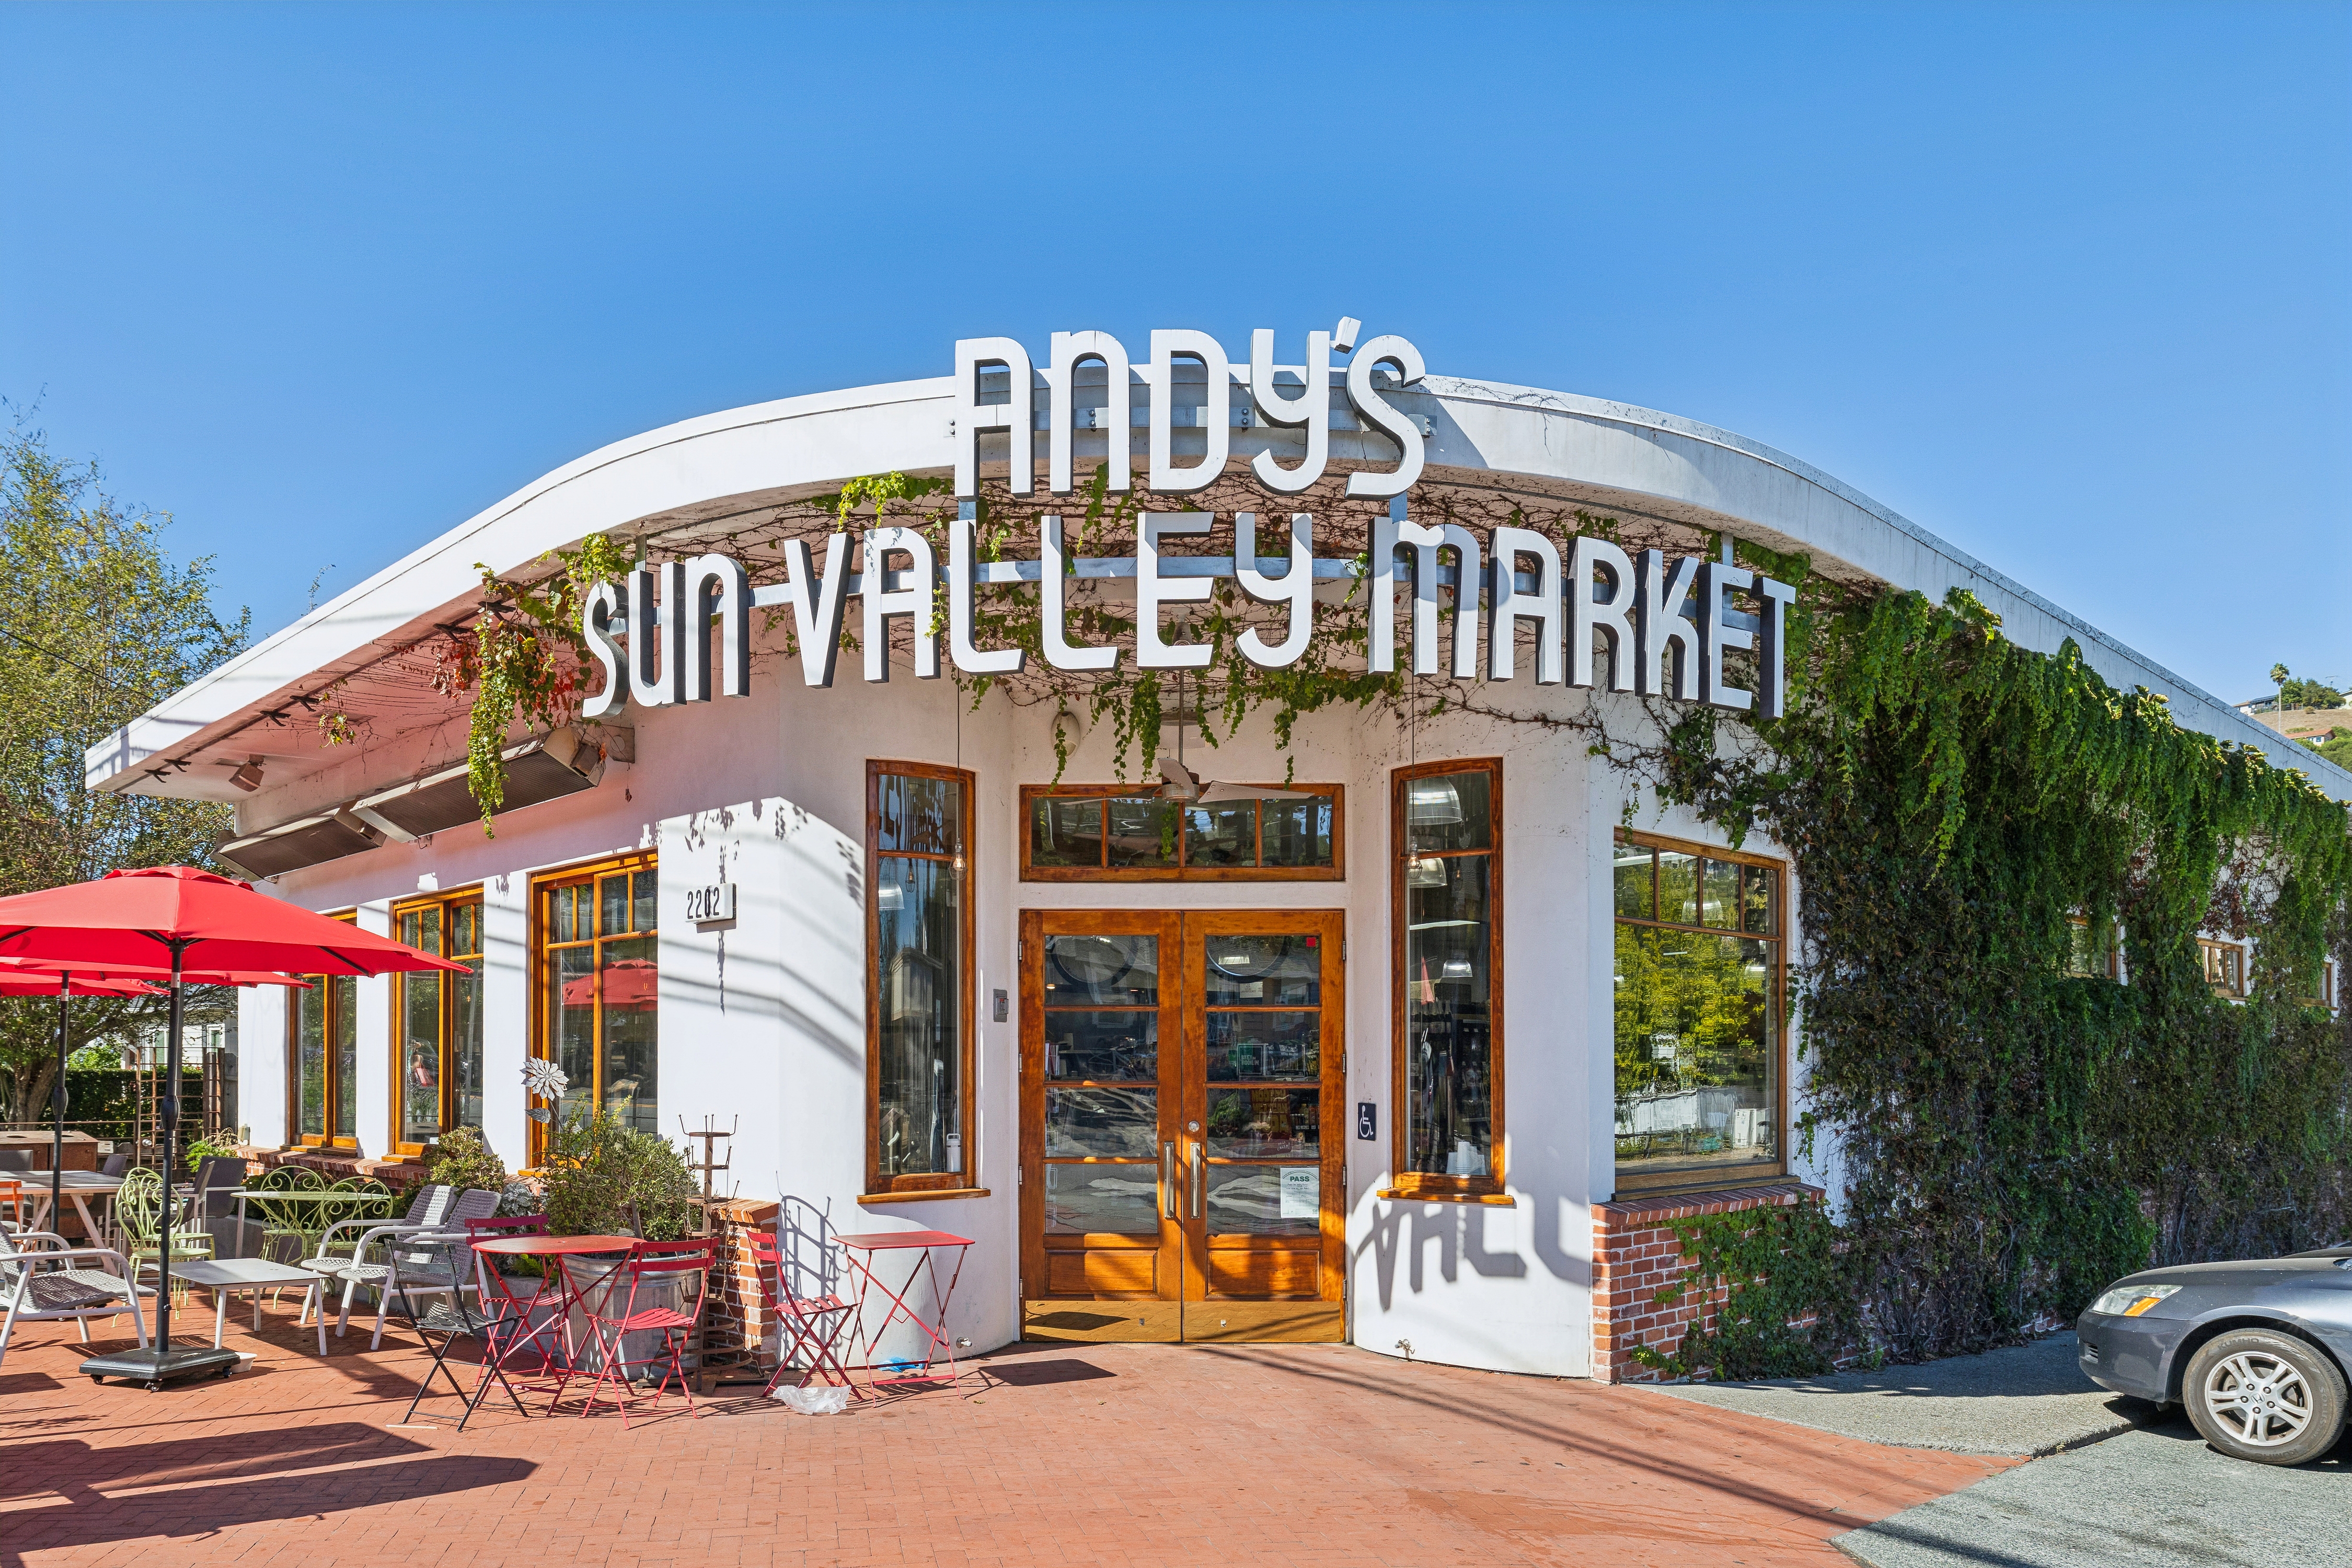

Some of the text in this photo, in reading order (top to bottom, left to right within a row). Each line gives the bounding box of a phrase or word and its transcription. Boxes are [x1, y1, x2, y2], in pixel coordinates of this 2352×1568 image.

[582, 512, 1796, 720] SUN VALLEY MARKET
[687, 887, 720, 919] 2202
[2217, 1338, 2259, 1350] KUMHO
